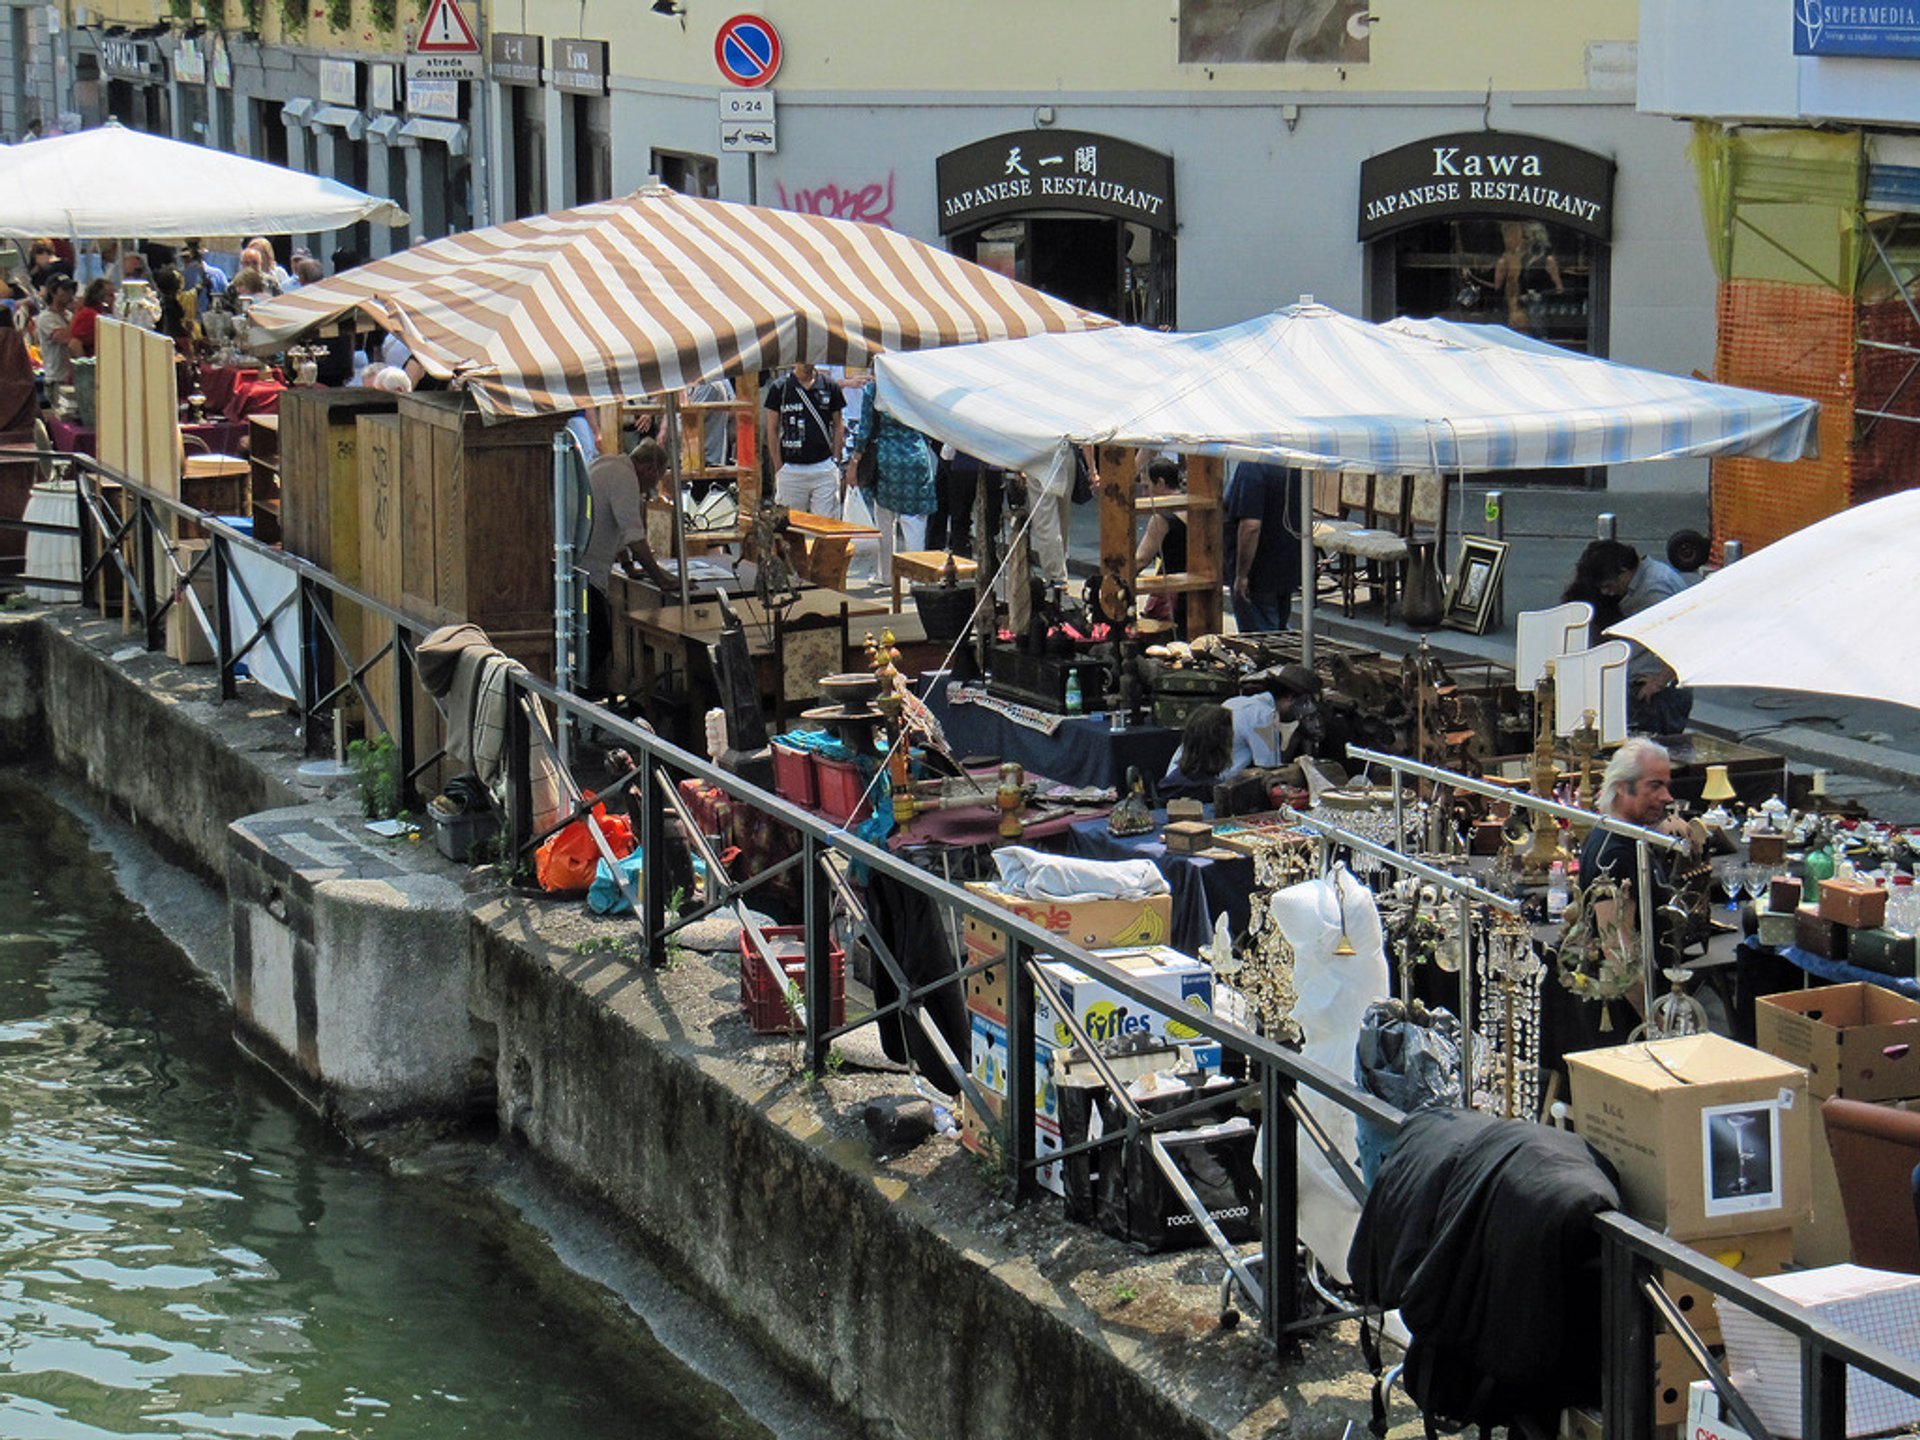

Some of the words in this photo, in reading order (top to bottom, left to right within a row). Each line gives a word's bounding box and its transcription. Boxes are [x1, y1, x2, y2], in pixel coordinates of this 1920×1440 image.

[426, 58, 463, 67] strada
[415, 69, 475, 78] dissestata
[731, 101, 762, 112] 0-24
[1432, 148, 1541, 176] Kawa
[945, 179, 1033, 217] JAPANESE
[1041, 177, 1164, 215] RESTAURANT
[1366, 183, 1460, 220] JAPANESE
[1470, 181, 1601, 222] RESTAURANT
